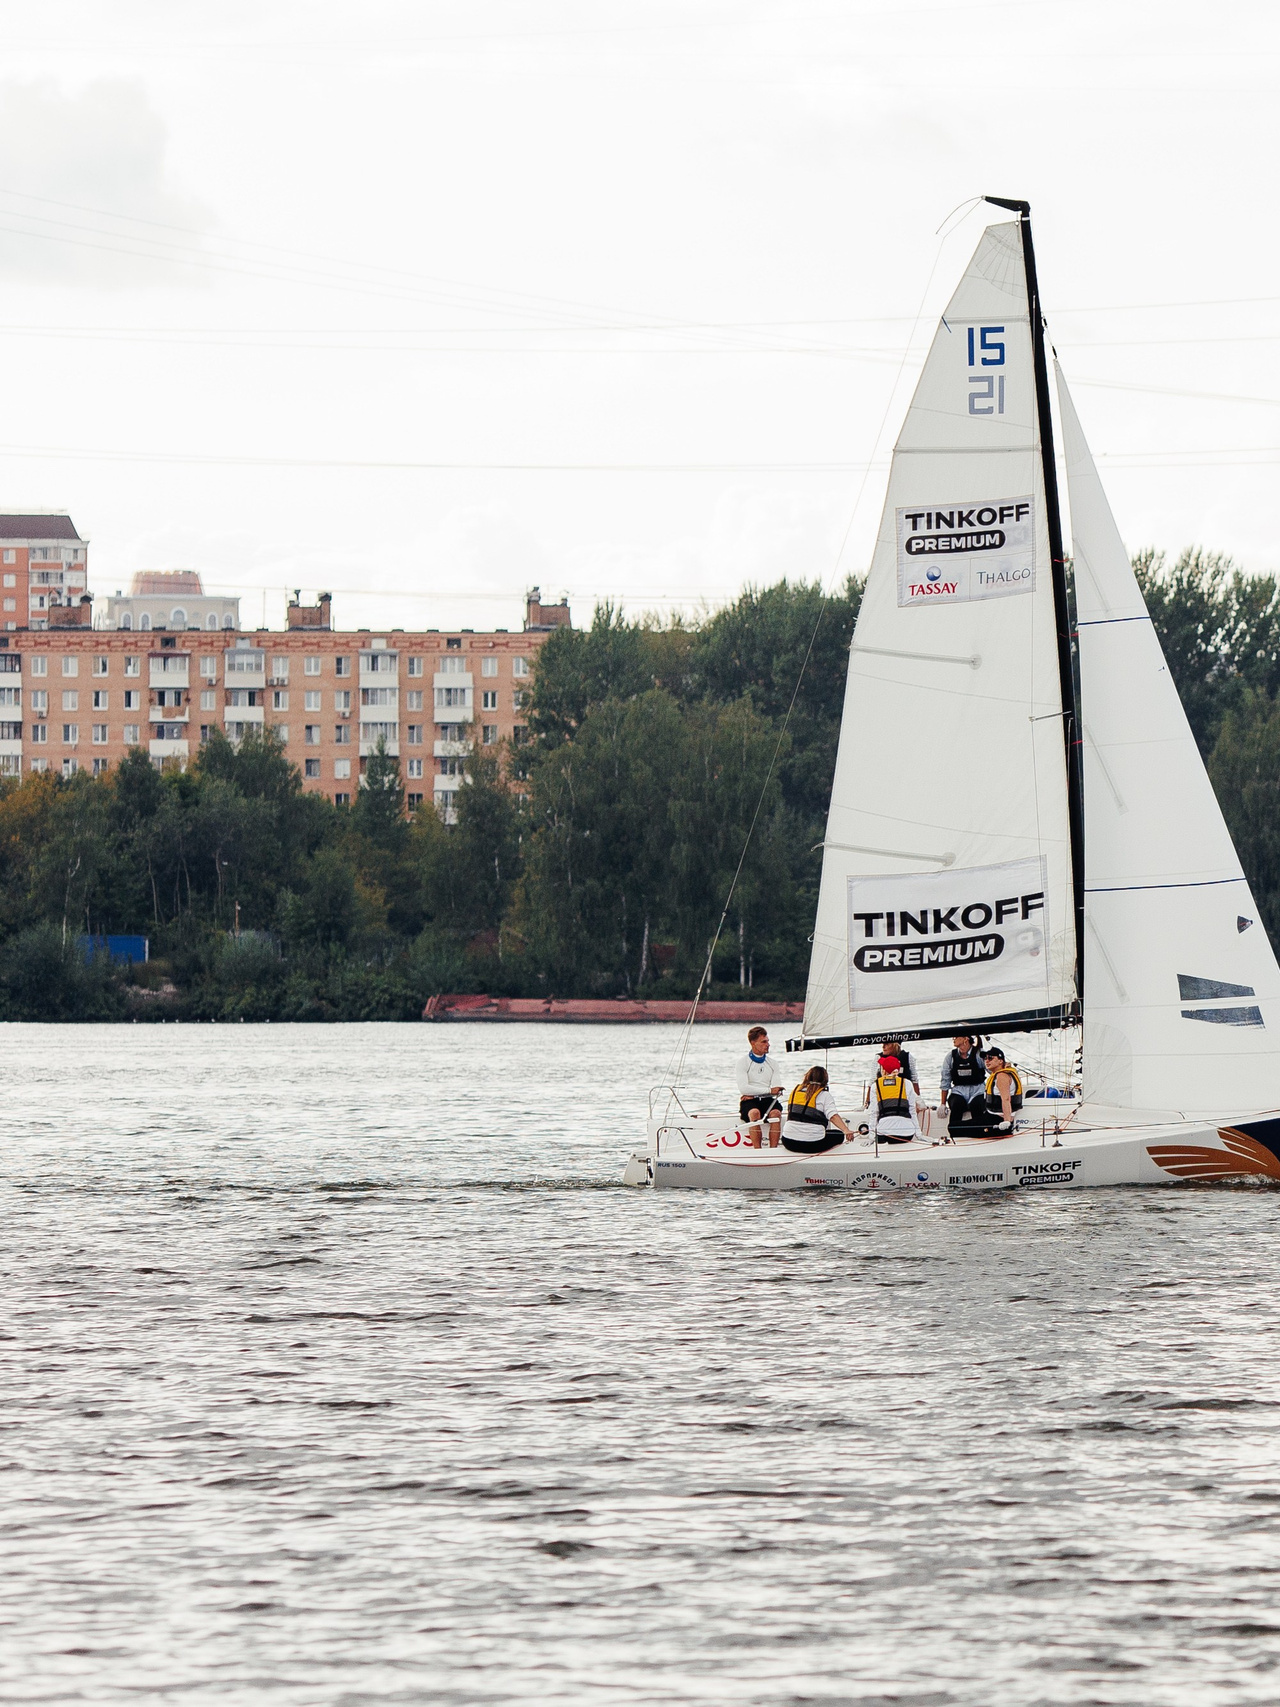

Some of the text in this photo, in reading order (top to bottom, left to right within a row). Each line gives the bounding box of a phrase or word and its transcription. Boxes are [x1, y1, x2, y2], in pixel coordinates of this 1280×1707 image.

[967, 326, 1005, 366] 15
[905, 503, 1030, 531] TINKOFF
[911, 533, 1000, 552] PREMIUM
[976, 568, 1031, 584] THALGO
[908, 582, 959, 596] TASSAY
[853, 892, 1045, 938] TINKOFF
[863, 938, 996, 968] PREMIUM
[852, 1032, 920, 1046] pro-yachting.ru
[1012, 1160, 1082, 1176] TINKOFF
[850, 1172, 897, 1187] МОРПРИБОР
[949, 1173, 1004, 1185] ВЕДОМОСТИ
[1022, 1174, 1071, 1185] PREMIUM
